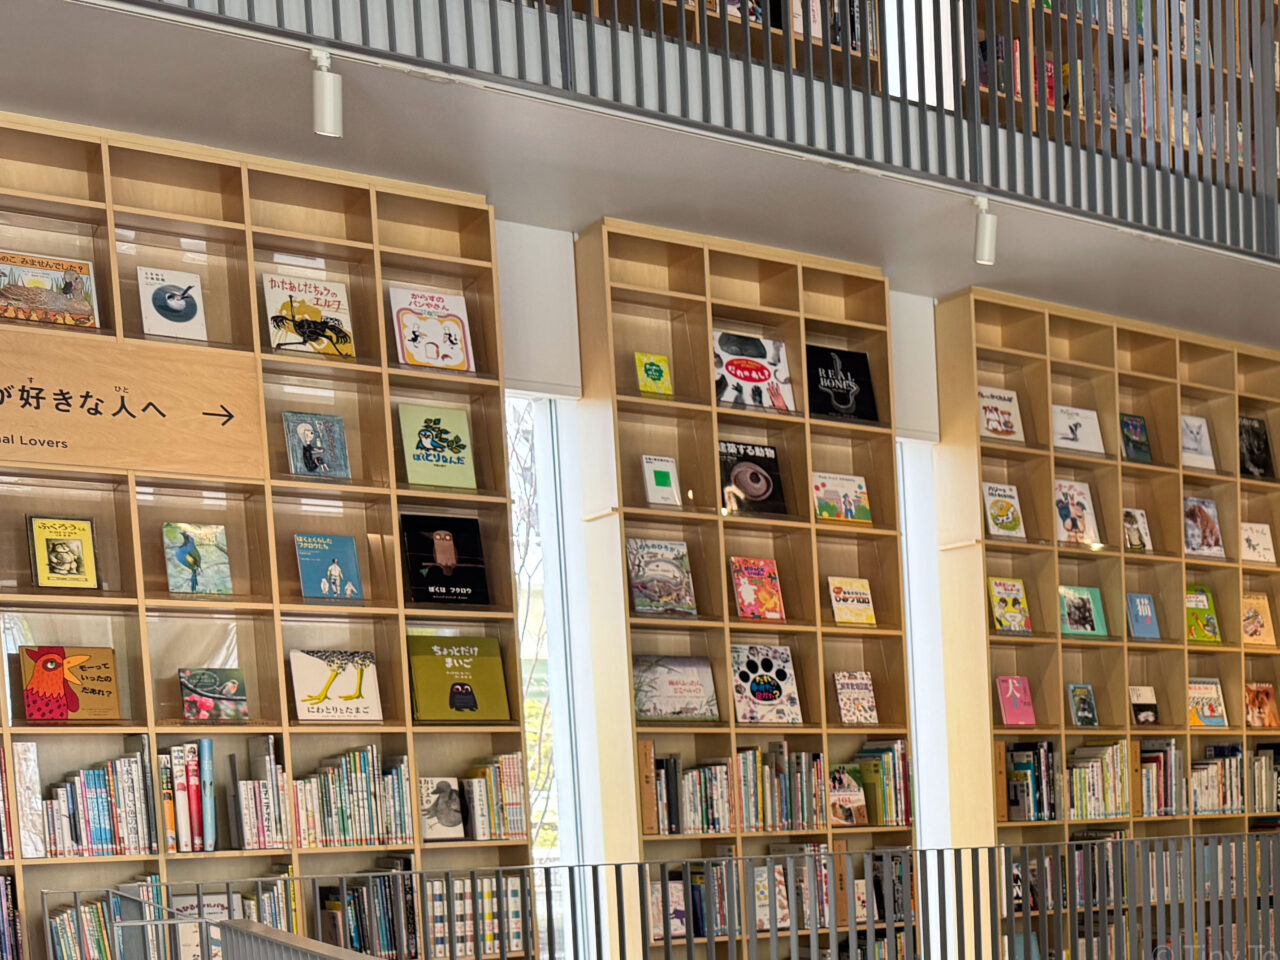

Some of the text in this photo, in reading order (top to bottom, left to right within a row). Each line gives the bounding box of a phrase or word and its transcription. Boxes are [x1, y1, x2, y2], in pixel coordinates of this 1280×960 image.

[269, 277, 338, 298] かたあしだちょうの
[410, 293, 445, 303] からすの
[313, 298, 342, 311] エルフ
[408, 301, 449, 311] パンやさん
[114, 385, 129, 393] ひと
[20, 435, 68, 449] Lovers
[428, 586, 472, 595] ぼくは フクロウ
[431, 645, 478, 657] ちょっとだけ
[444, 658, 472, 669] まいご
[81, 674, 112, 683] いったの
[81, 687, 113, 698] だあれ?
[307, 705, 370, 715] にわとりとたまご
